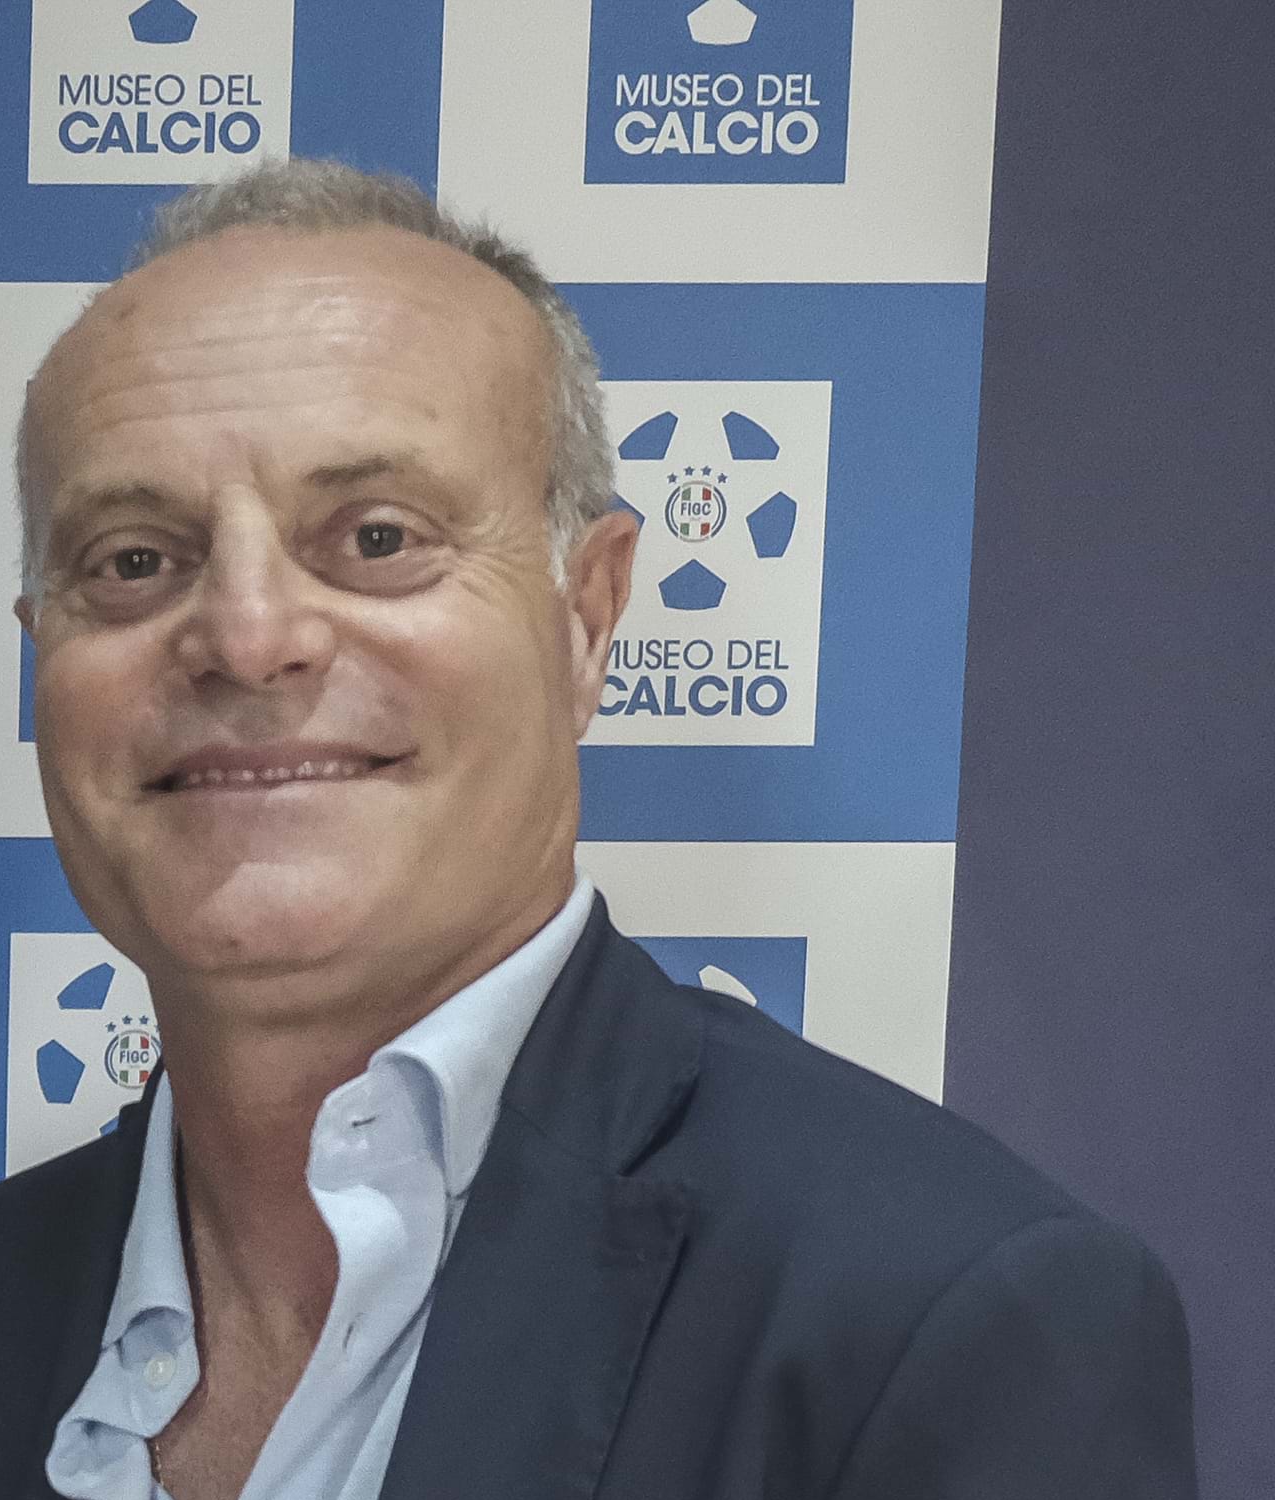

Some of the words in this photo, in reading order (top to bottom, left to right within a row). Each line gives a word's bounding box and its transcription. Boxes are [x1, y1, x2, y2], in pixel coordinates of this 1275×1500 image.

[59, 74, 185, 106] MUSEO
[199, 74, 262, 105] DEL
[615, 74, 744, 106] MUSEO
[757, 74, 820, 106] DEL
[58, 111, 261, 154] CALCIO
[615, 110, 819, 155] CALCIO
[679, 502, 712, 516] FIGC
[727, 639, 789, 670] DEL
[598, 675, 788, 717] CALCIO
[118, 1050, 150, 1064] FIGC
